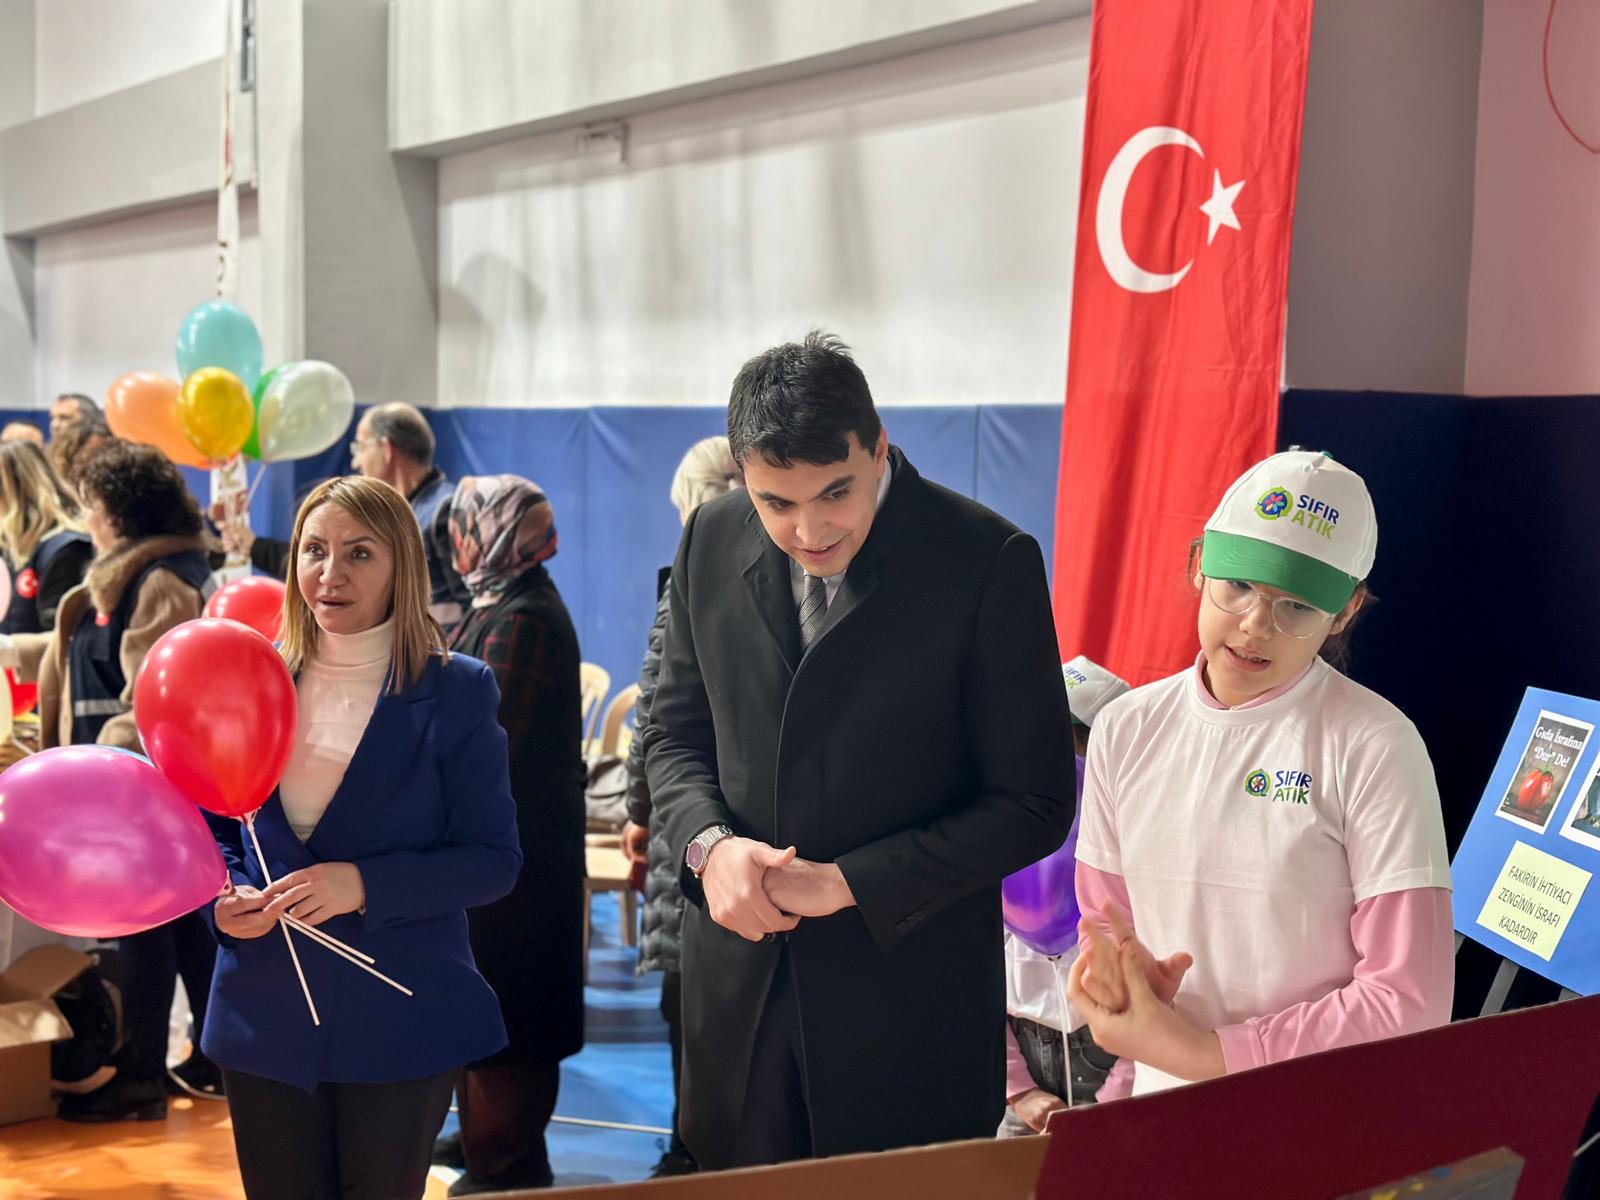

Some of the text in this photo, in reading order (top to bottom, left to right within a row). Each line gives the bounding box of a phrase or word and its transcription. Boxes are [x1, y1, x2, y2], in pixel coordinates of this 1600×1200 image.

[1291, 509, 1335, 540] ATIK
[1297, 494, 1340, 525] SIFIR
[1274, 770, 1313, 788] SIFIR
[1272, 787, 1310, 805] ATIK
[1508, 865, 1573, 905] FAKİRİN İHTİYACI
[1498, 887, 1561, 928] ZENGİNİN İSRAFI
[1498, 915, 1538, 945] KADARDIR
